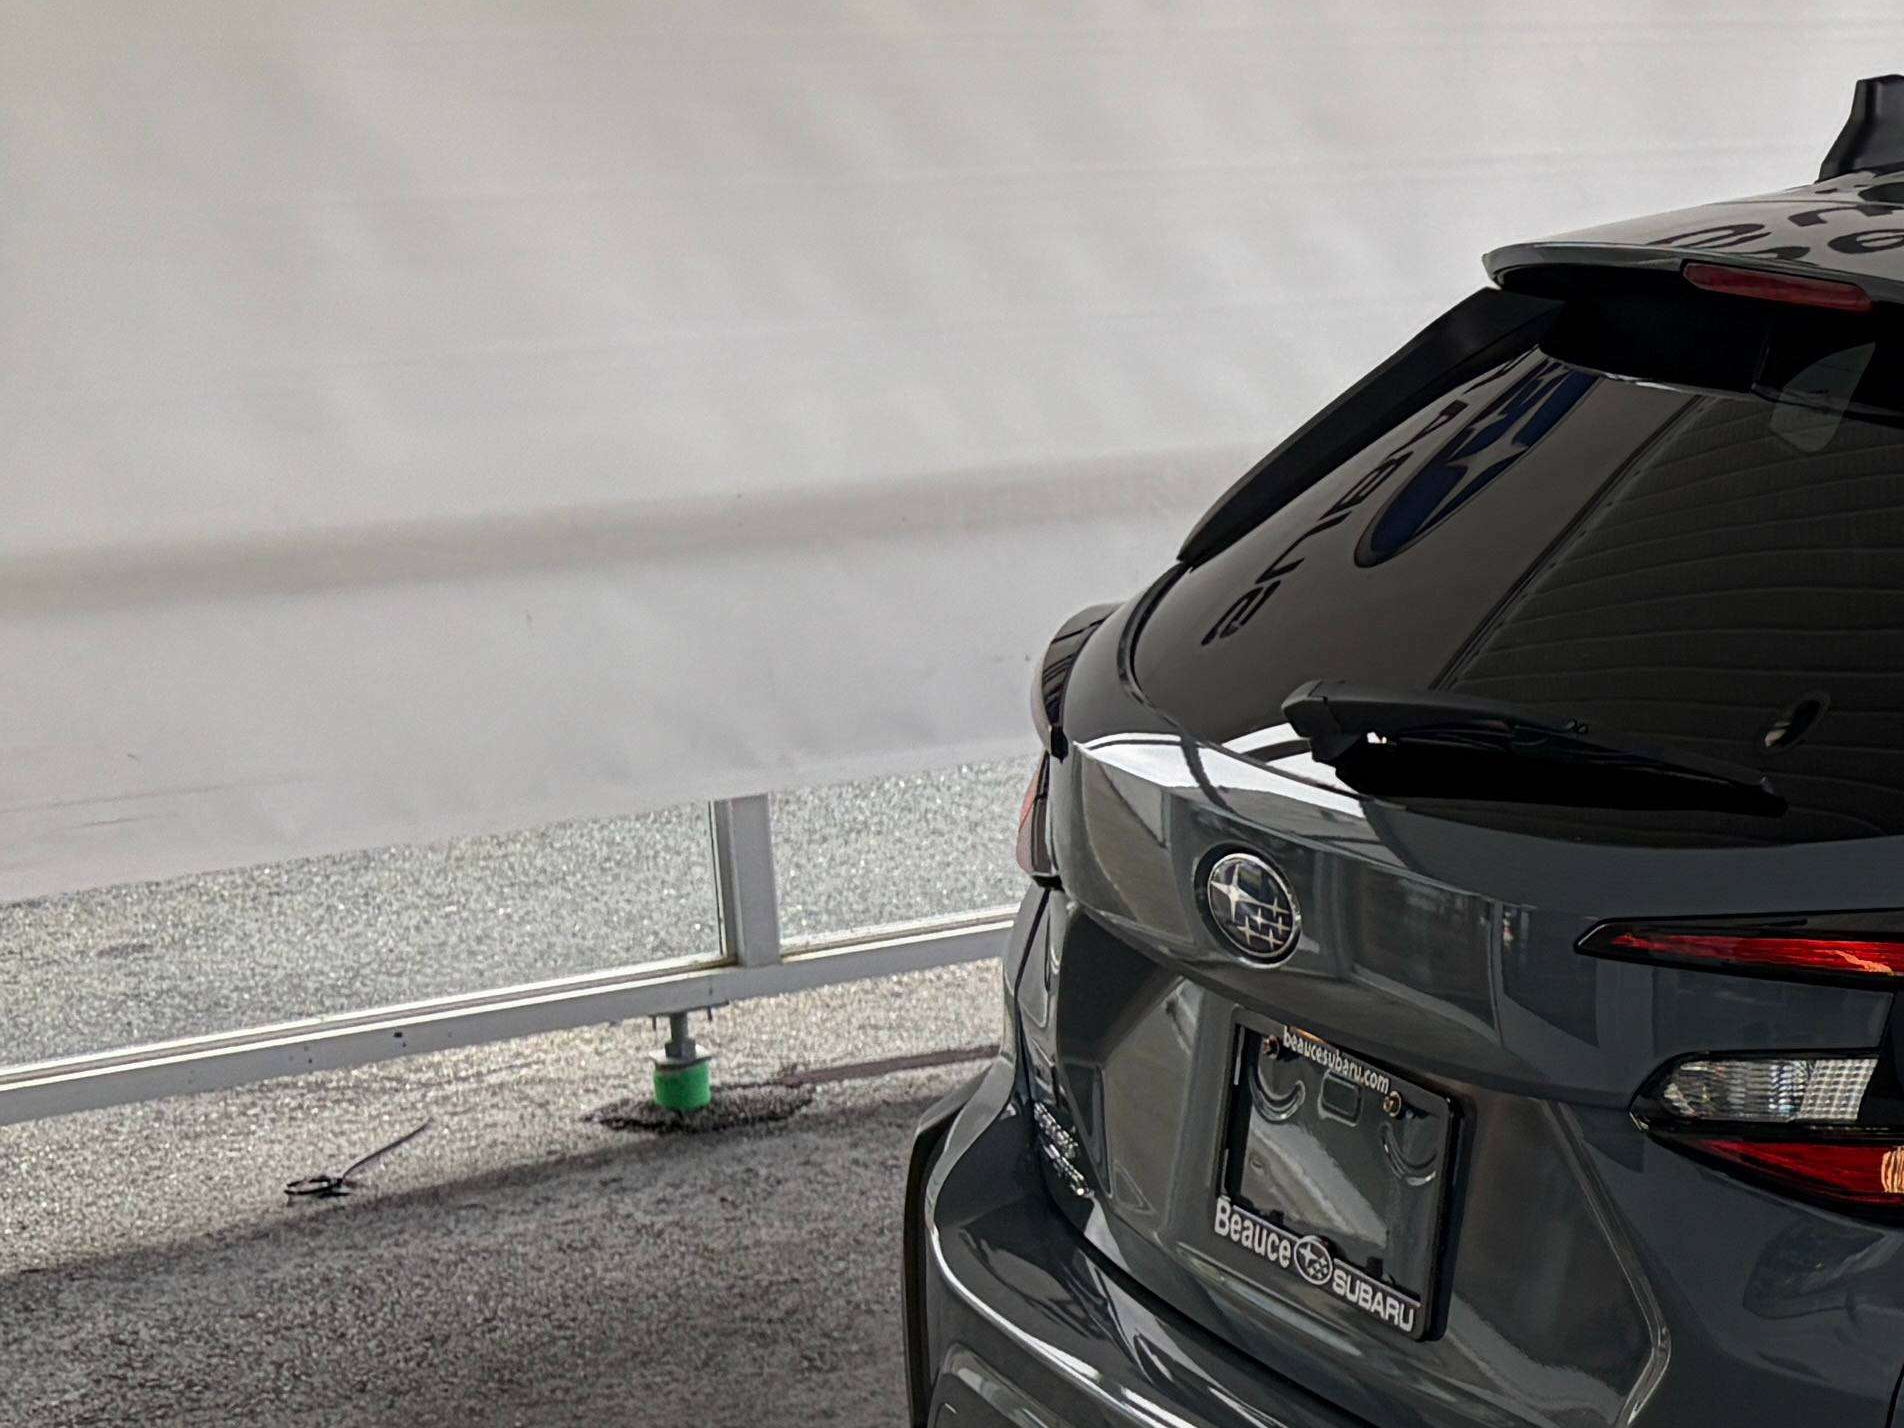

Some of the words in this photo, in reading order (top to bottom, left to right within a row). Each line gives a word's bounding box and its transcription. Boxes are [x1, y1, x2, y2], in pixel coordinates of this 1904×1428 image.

[1282, 1025, 1390, 1095] beaucesubaru.com
[1214, 1195, 1292, 1269] Beauce
[1332, 1269, 1415, 1332] SUBARU
